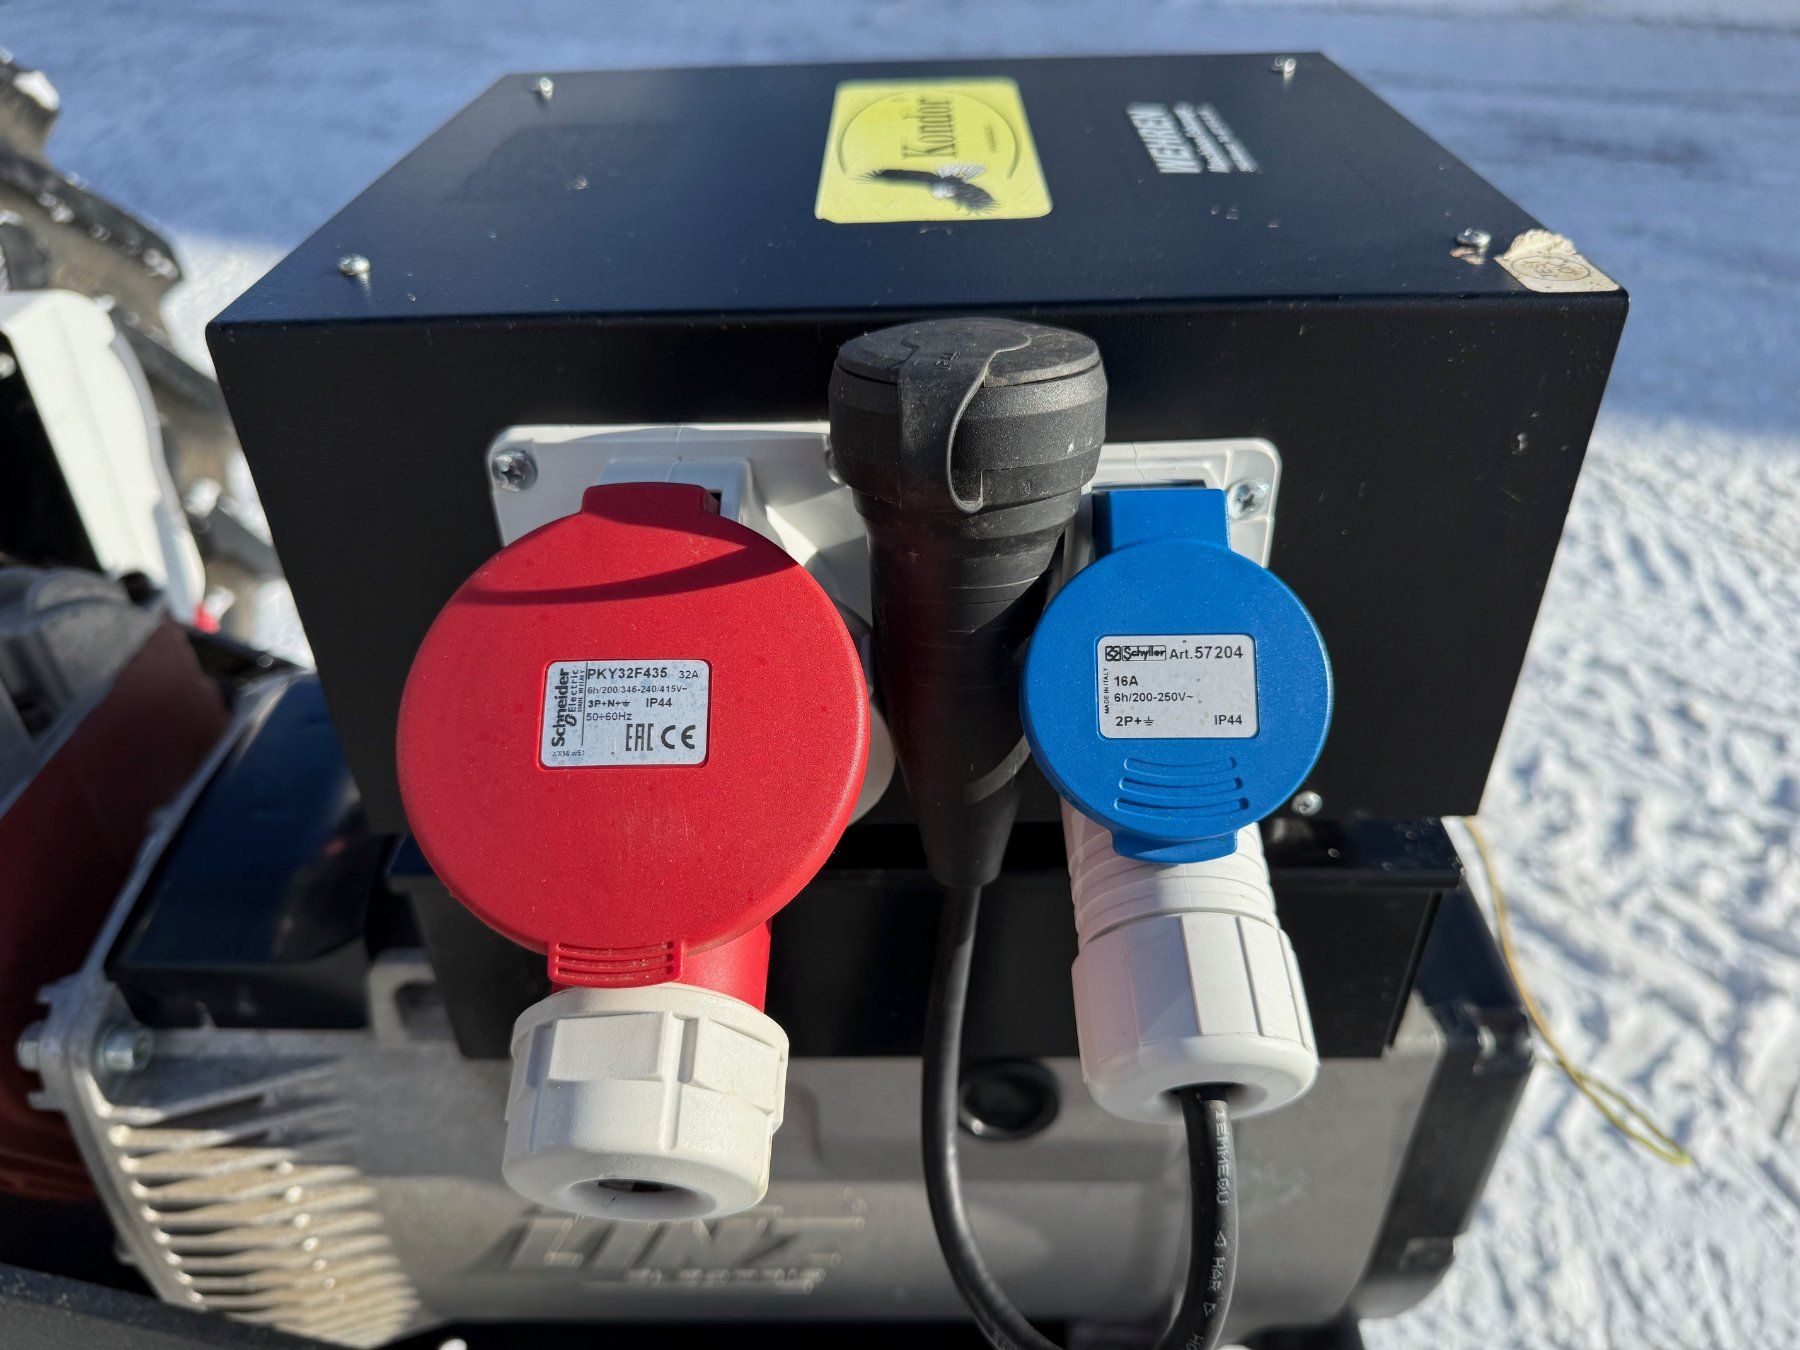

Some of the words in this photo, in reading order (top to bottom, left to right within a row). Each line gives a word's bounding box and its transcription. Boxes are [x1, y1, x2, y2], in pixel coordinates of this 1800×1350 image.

[901, 98, 956, 158] Kondor
[1123, 646, 1166, 660] Schyller
[587, 667, 668, 680] PKY32F435
[679, 670, 699, 679] 32A
[1114, 675, 1139, 687] 16A
[568, 669, 578, 712] Electric
[551, 668, 569, 747] Schneider
[646, 697, 672, 707] IP44
[586, 712, 632, 721] 50÷60Hz
[1214, 714, 1243, 725] IP44
